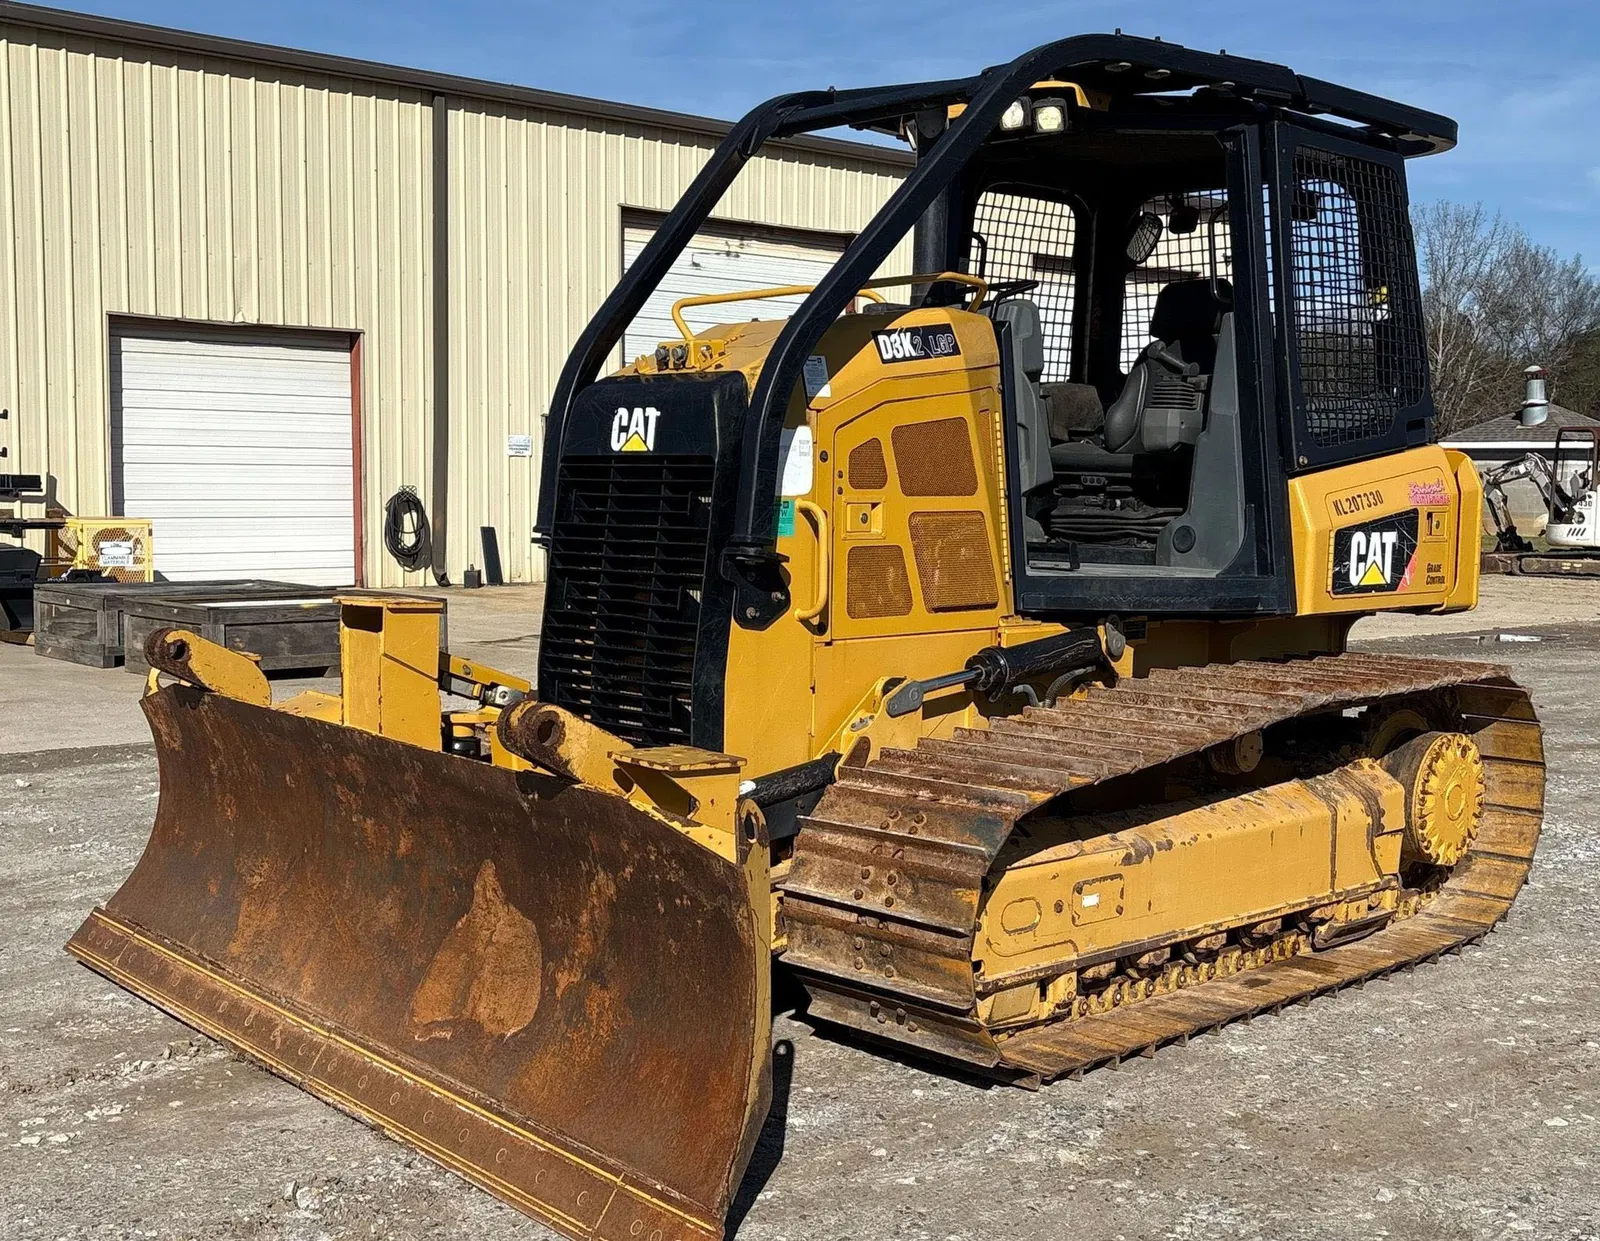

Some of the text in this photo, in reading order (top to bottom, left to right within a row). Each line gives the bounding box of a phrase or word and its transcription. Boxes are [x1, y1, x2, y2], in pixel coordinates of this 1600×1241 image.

[928, 333, 955, 355] LGP
[610, 406, 661, 452] CAT
[1332, 489, 1384, 517] KL207330
[1350, 531, 1398, 586] CAT
